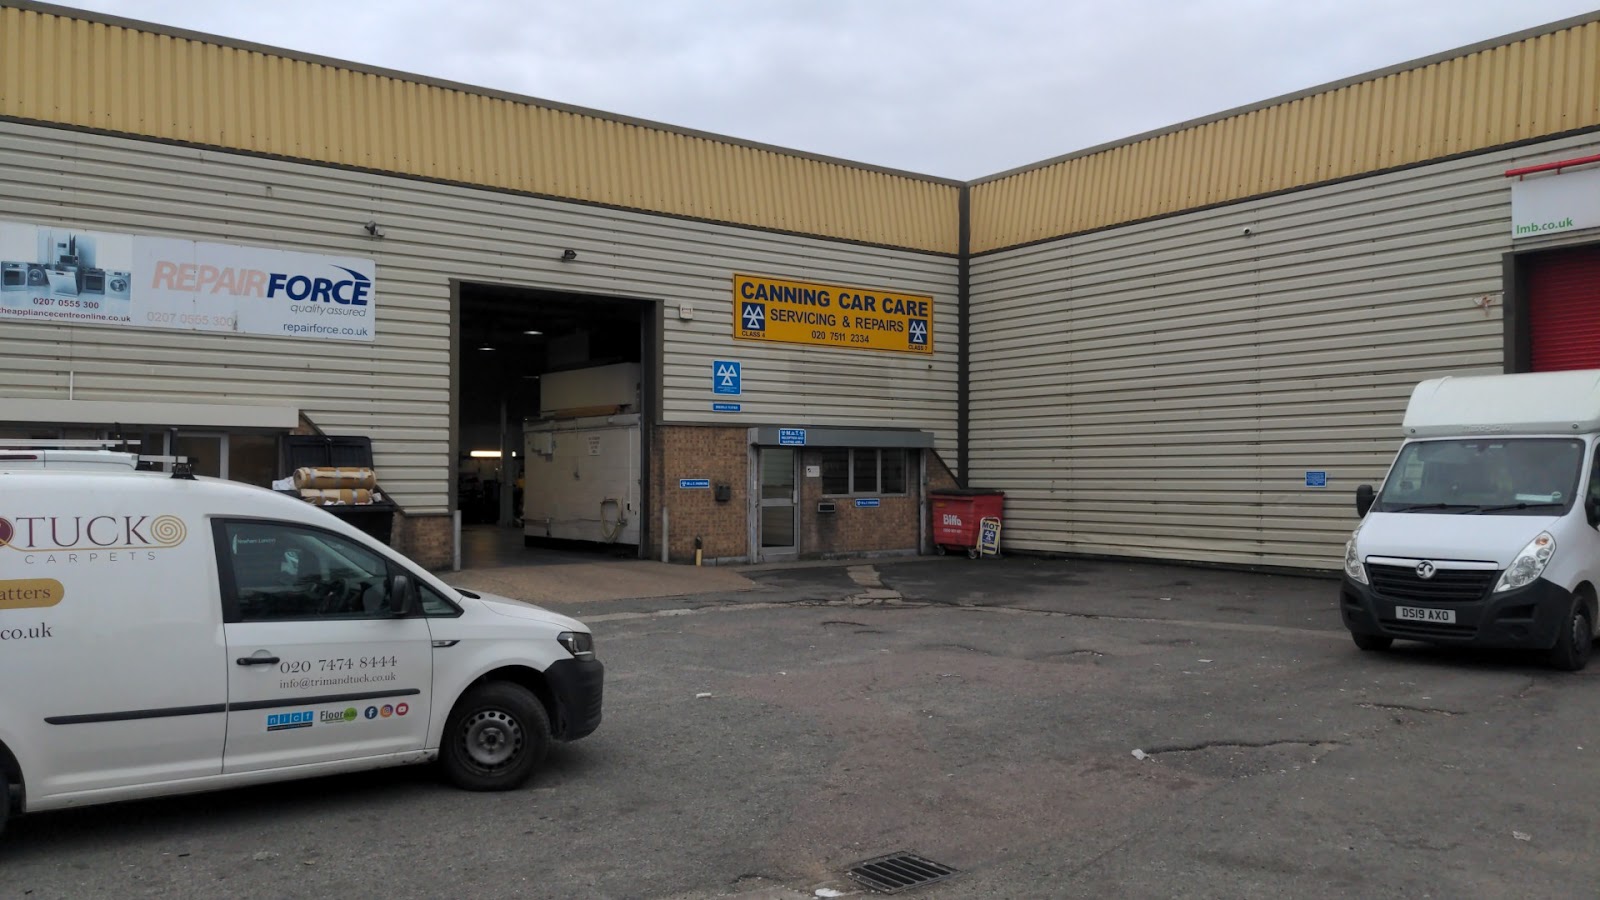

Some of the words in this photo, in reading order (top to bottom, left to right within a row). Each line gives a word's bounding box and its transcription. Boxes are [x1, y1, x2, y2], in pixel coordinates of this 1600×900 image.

[1516, 217, 1573, 234] lmb.co.uk
[33, 297, 55, 306] 0207
[58, 299, 80, 308] 0555
[83, 301, 99, 309] 300
[741, 281, 831, 307] CANNING
[838, 292, 876, 312] CAR
[882, 298, 929, 317] CARE
[290, 303, 326, 315] quality
[327, 306, 366, 317] assured
[147, 311, 176, 323] 0207
[213, 315, 234, 327] 300
[770, 308, 836, 326] SERVICING
[842, 315, 850, 328] &
[855, 317, 904, 332] REPAIRS
[283, 322, 368, 337] repairforce.co.uk
[811, 330, 826, 340] 020
[829, 331, 846, 342] 7511
[850, 333, 870, 344] 2334
[943, 513, 962, 526] Biffa
[982, 522, 1000, 531] MOT
[16, 515, 151, 547] TUCK
[25, 551, 156, 565] CARPETS
[1402, 607, 1425, 619] DS19
[1428, 609, 1449, 621] AXO
[280, 660, 311, 674] 020
[318, 658, 354, 672] 7474
[359, 655, 398, 669] 8444
[279, 672, 396, 689] info@trimandtuck.co.uk
[320, 710, 344, 720] Floor
